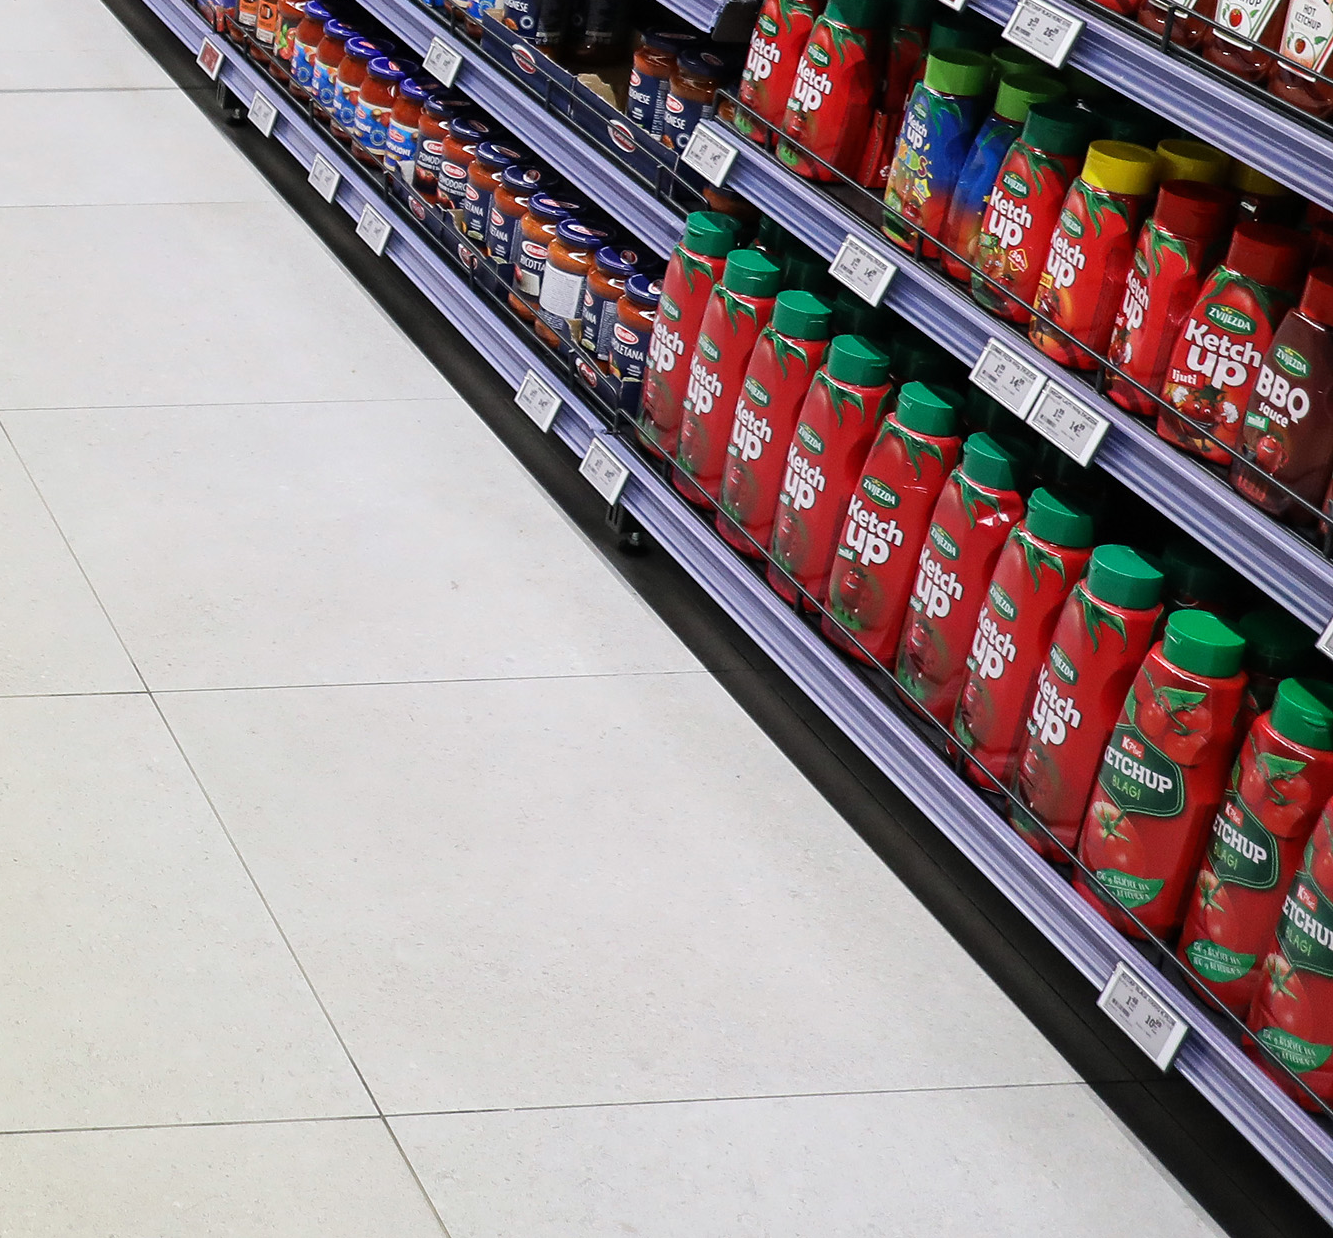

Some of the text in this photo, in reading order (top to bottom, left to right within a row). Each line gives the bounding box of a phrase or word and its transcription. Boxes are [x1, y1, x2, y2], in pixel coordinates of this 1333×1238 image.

[1295, 11, 1322, 32] KETCHUP
[1304, 4, 1317, 17] HOT
[747, 49, 771, 81] up
[751, 29, 781, 63] Ketch
[794, 80, 822, 113] up
[797, 56, 833, 95] Ketch
[990, 187, 1032, 229] Ketch
[988, 213, 1024, 248] up
[1051, 228, 1086, 270] Ketch
[1046, 253, 1076, 290] up
[1209, 307, 1252, 331] ZVIJEZDA
[1184, 319, 1264, 368] Ketch
[1276, 347, 1308, 375] ZVIJEZDA
[691, 354, 723, 398] Ketch
[1171, 370, 1198, 387] ljuti
[1186, 345, 1248, 391] up
[687, 376, 714, 416] up
[1255, 364, 1311, 424] BBQ
[1258, 401, 1290, 429] sauce
[735, 396, 773, 443] Ketch
[1246, 414, 1266, 430] mild
[732, 423, 763, 463] up
[788, 442, 826, 492] Ketch
[784, 469, 816, 512] up
[863, 478, 896, 505] ZVIJEZDA
[850, 494, 905, 548] Ketch
[846, 522, 891, 567] up
[915, 569, 952, 619] up
[918, 547, 965, 601] Ketch
[977, 605, 1018, 663] Ketch
[972, 633, 1005, 680] up
[1032, 691, 1067, 747] up
[1038, 667, 1082, 729] Ketch
[1112, 774, 1141, 801] BLAGI
[1213, 814, 1268, 865] ETCHUP
